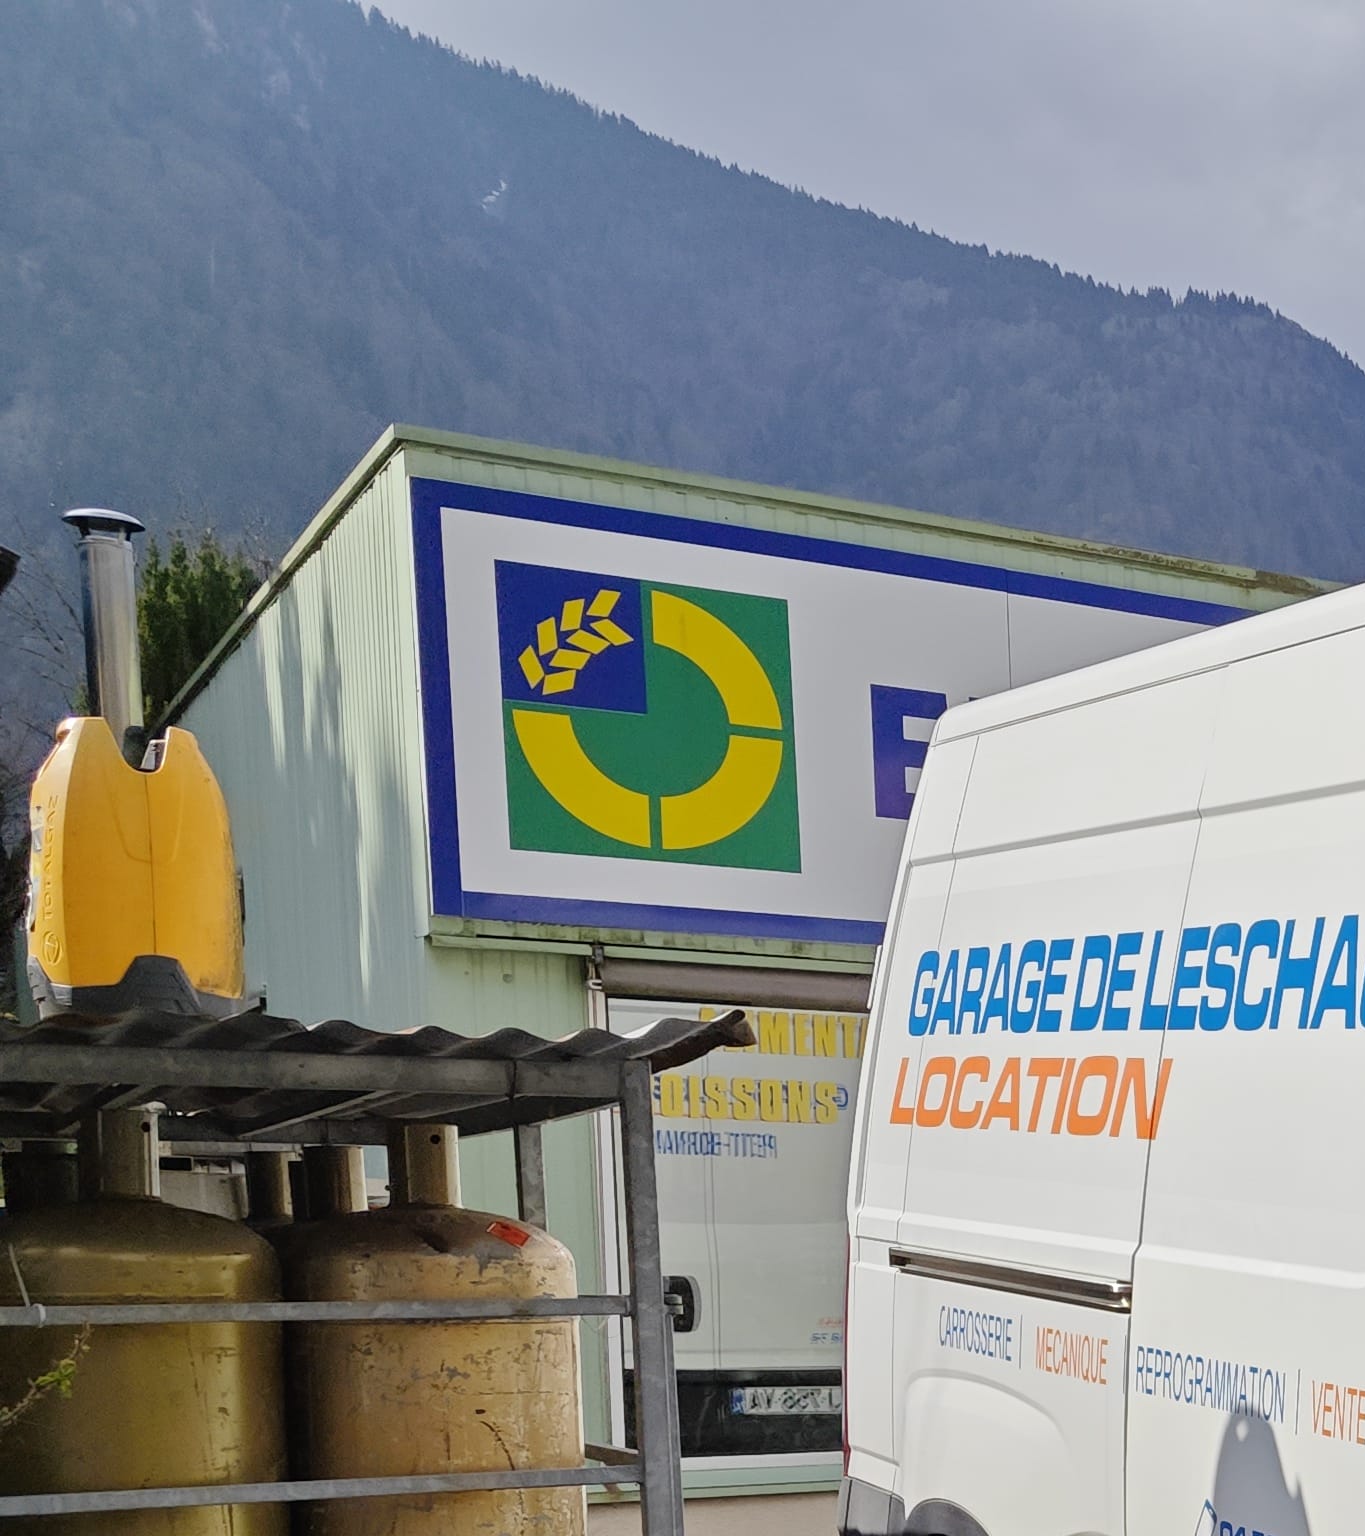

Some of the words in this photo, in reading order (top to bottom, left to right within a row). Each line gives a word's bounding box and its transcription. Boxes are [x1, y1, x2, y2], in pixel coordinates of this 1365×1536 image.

[908, 938, 1075, 1036] GARAGE
[1070, 932, 1143, 1031] DE
[653, 1073, 839, 1123] OISSONS
[889, 1055, 1173, 1140] LOCATION
[939, 1305, 1012, 1361] CARROSSERIE
[1035, 1325, 1109, 1385] MECANIQUE
[1136, 1345, 1286, 1424] REPROGRAMMATION
